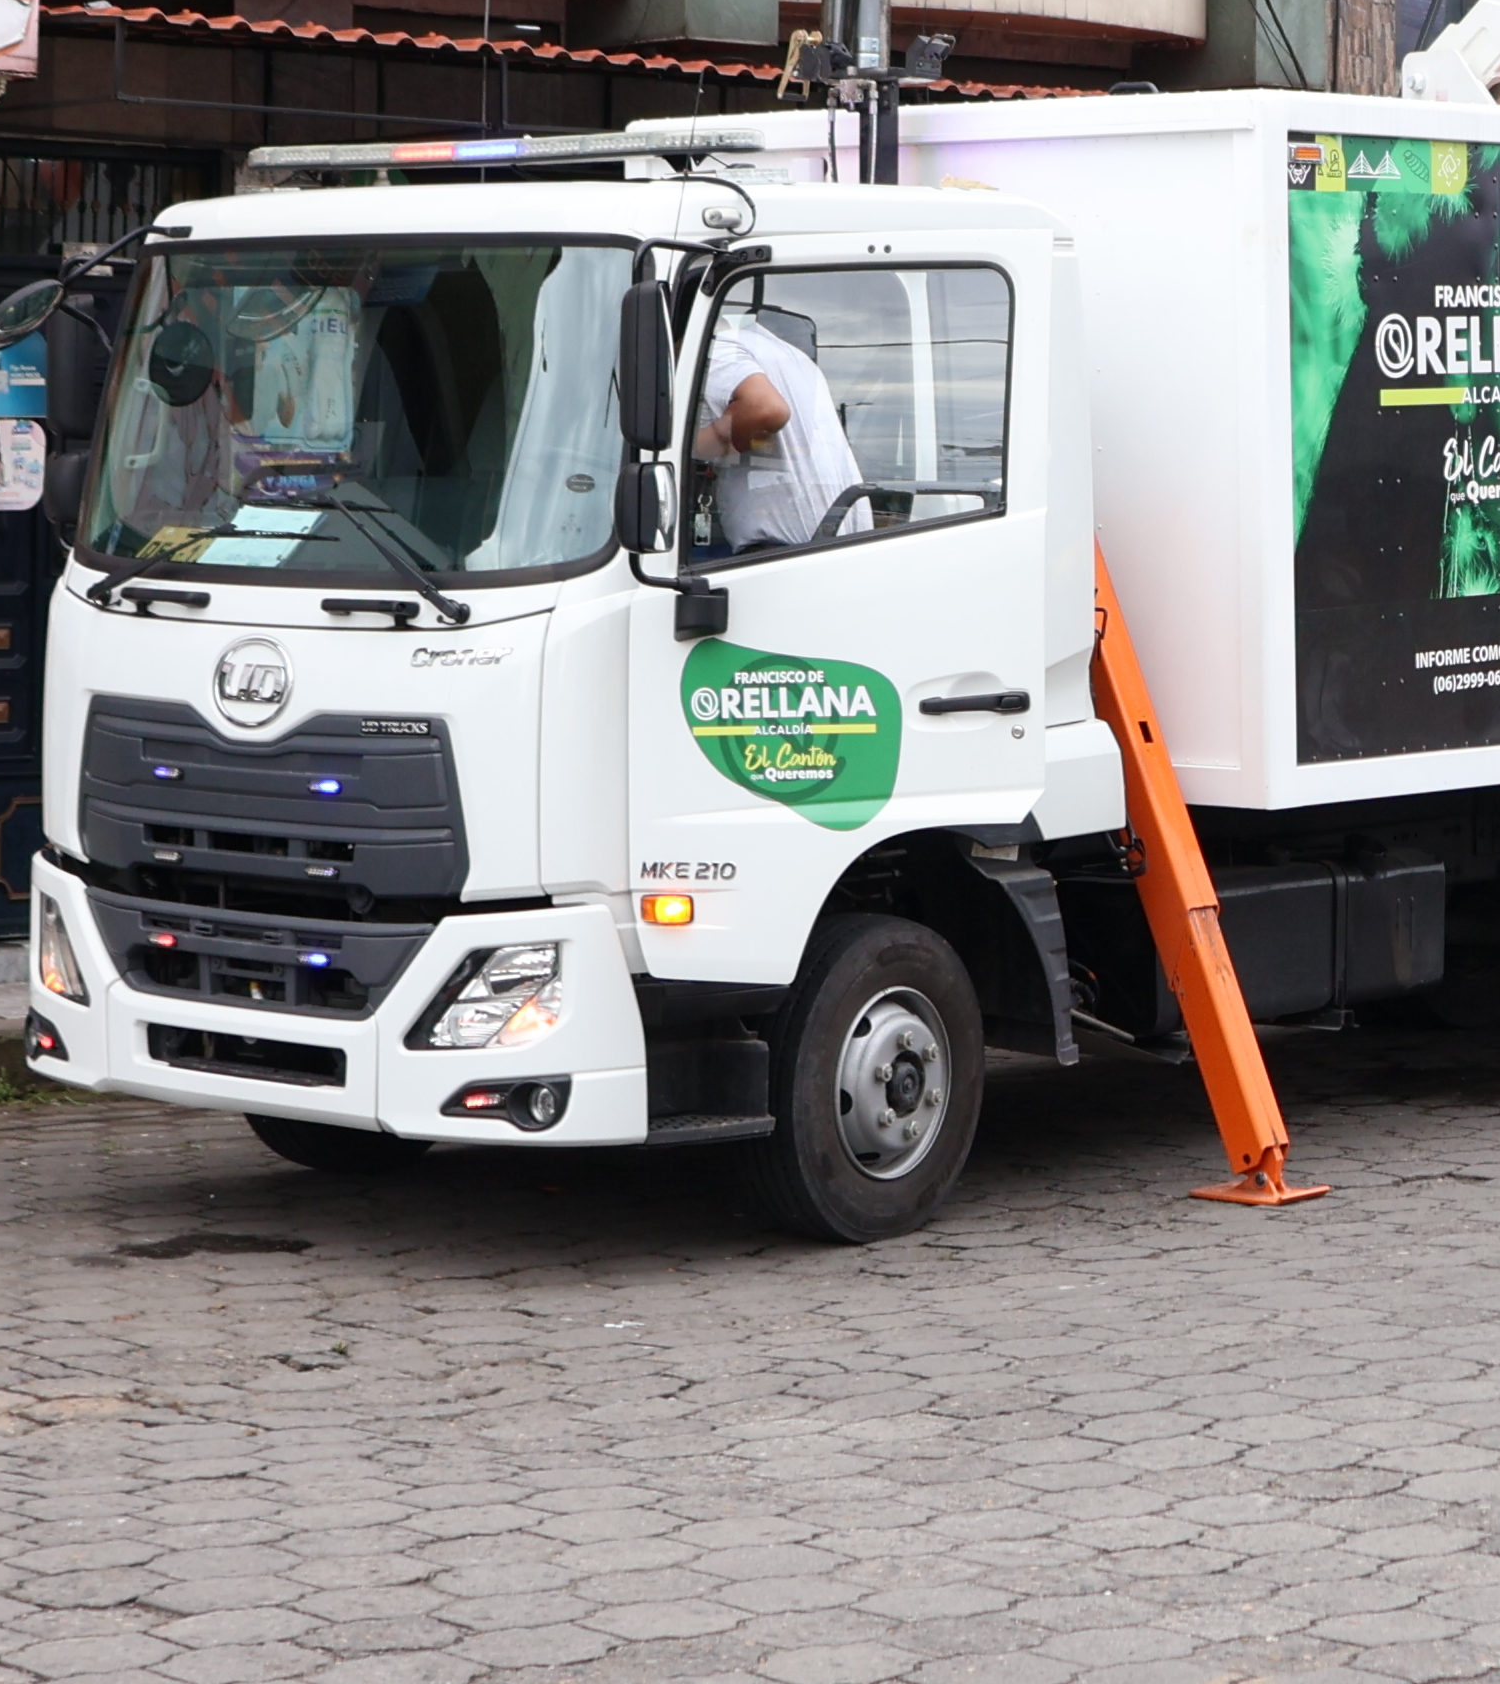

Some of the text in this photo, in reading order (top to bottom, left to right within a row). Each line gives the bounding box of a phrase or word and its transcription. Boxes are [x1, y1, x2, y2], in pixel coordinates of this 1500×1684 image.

[1443, 437, 1474, 482] El
[1450, 491, 1466, 502] que
[410, 647, 512, 667] Croner
[1415, 647, 1471, 669] INFORME
[734, 671, 825, 685] FRANCISCO DE
[691, 686, 877, 721] ORELLANA
[381, 721, 429, 734] TRUCKS
[753, 722, 813, 736] ALCALDÍA
[744, 742, 837, 771] El Cantón
[750, 767, 834, 783] que Queremos
[641, 862, 737, 881] MKE 210
